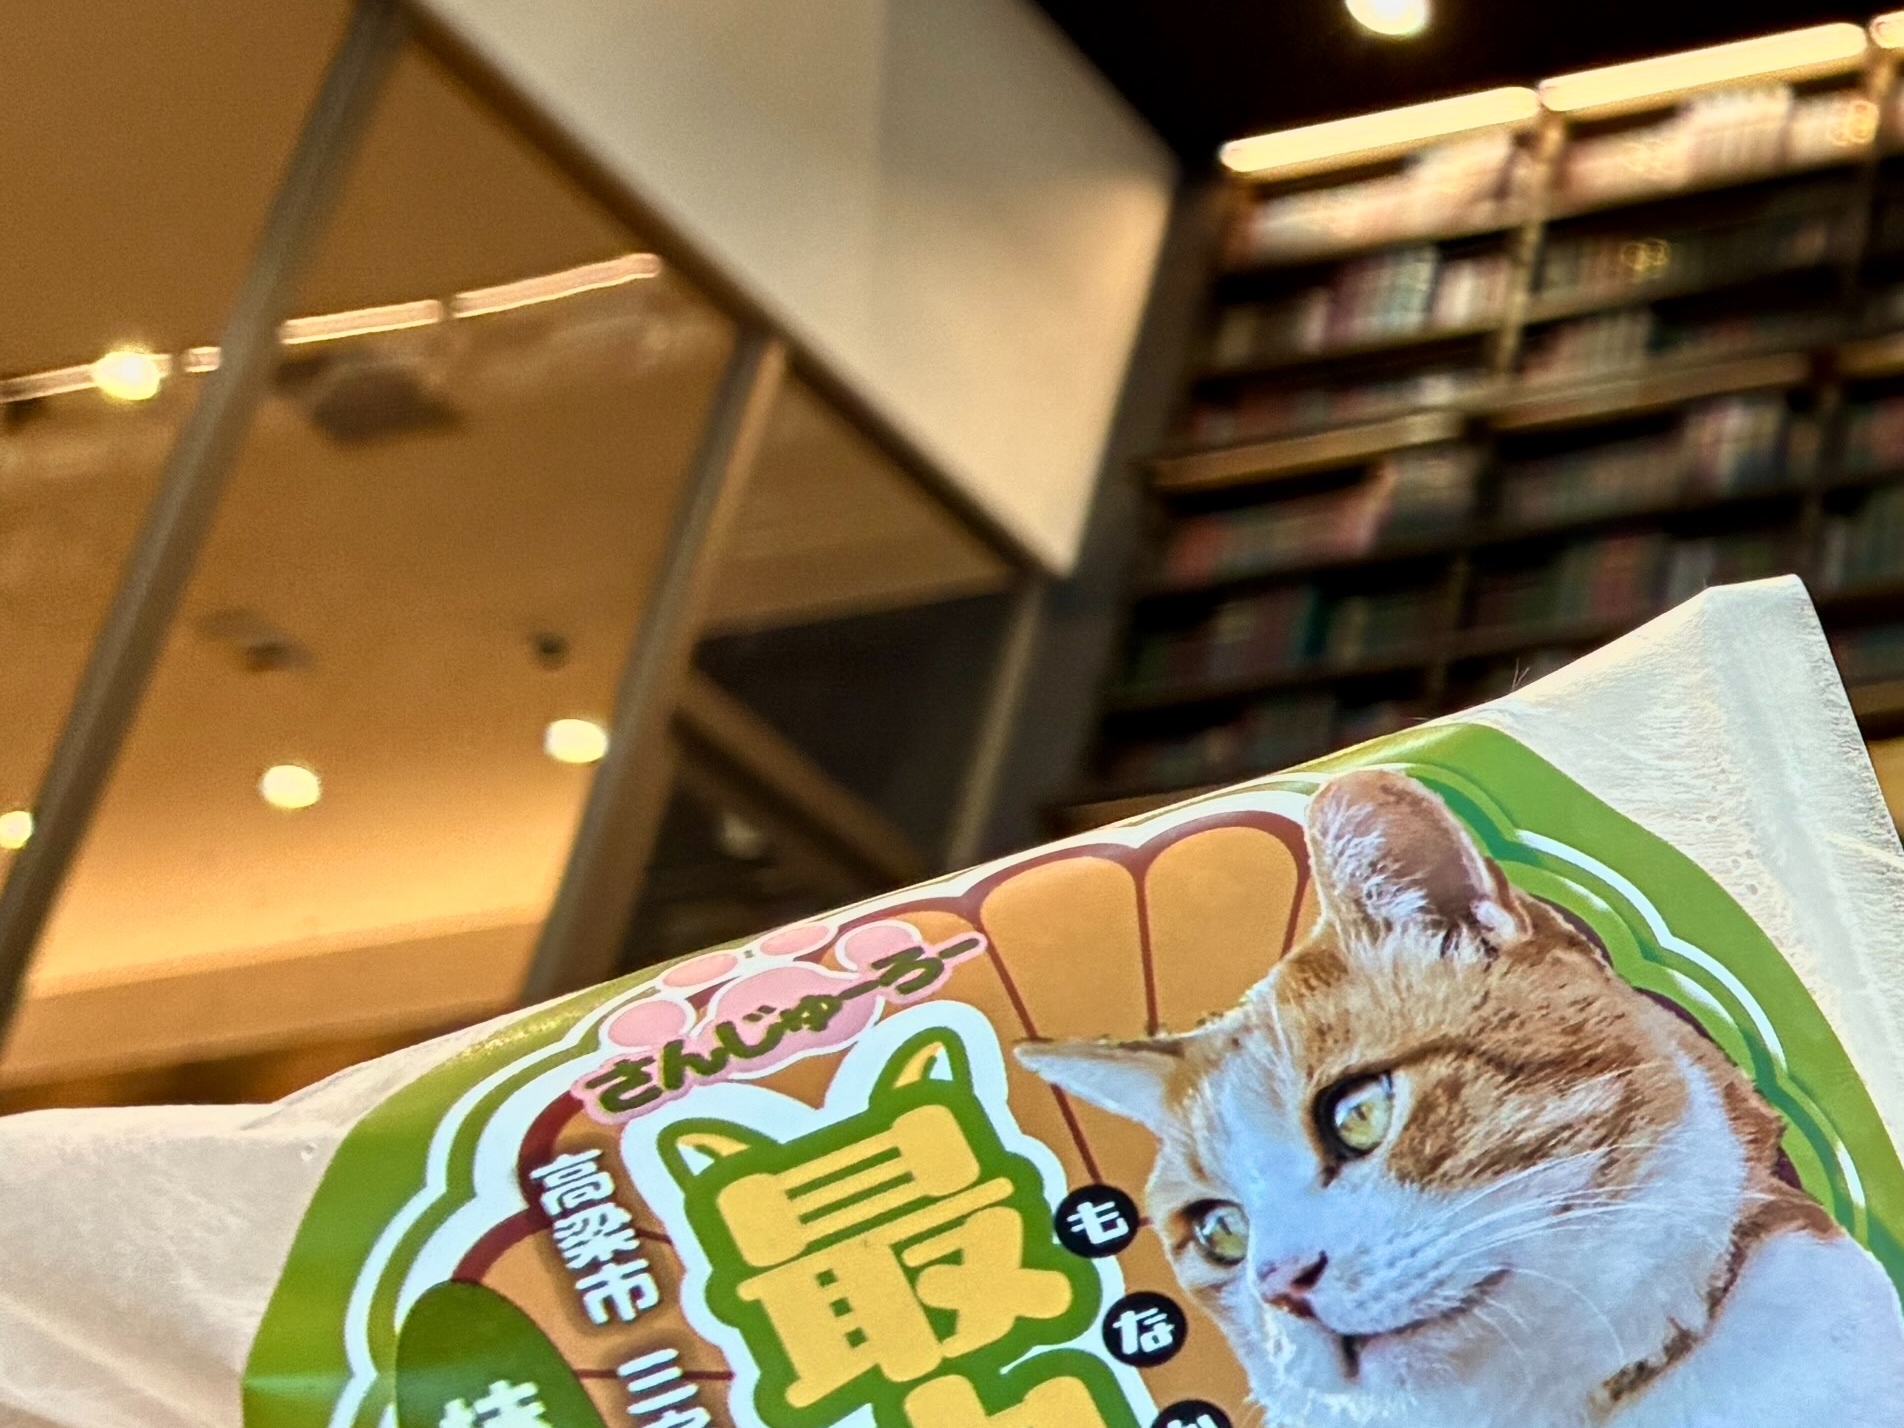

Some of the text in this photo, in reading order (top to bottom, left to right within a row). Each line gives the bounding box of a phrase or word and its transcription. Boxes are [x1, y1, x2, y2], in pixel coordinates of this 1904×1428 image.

[585, 938, 979, 1112] さんじゅーろー
[529, 1148, 660, 1325] 高梁市
